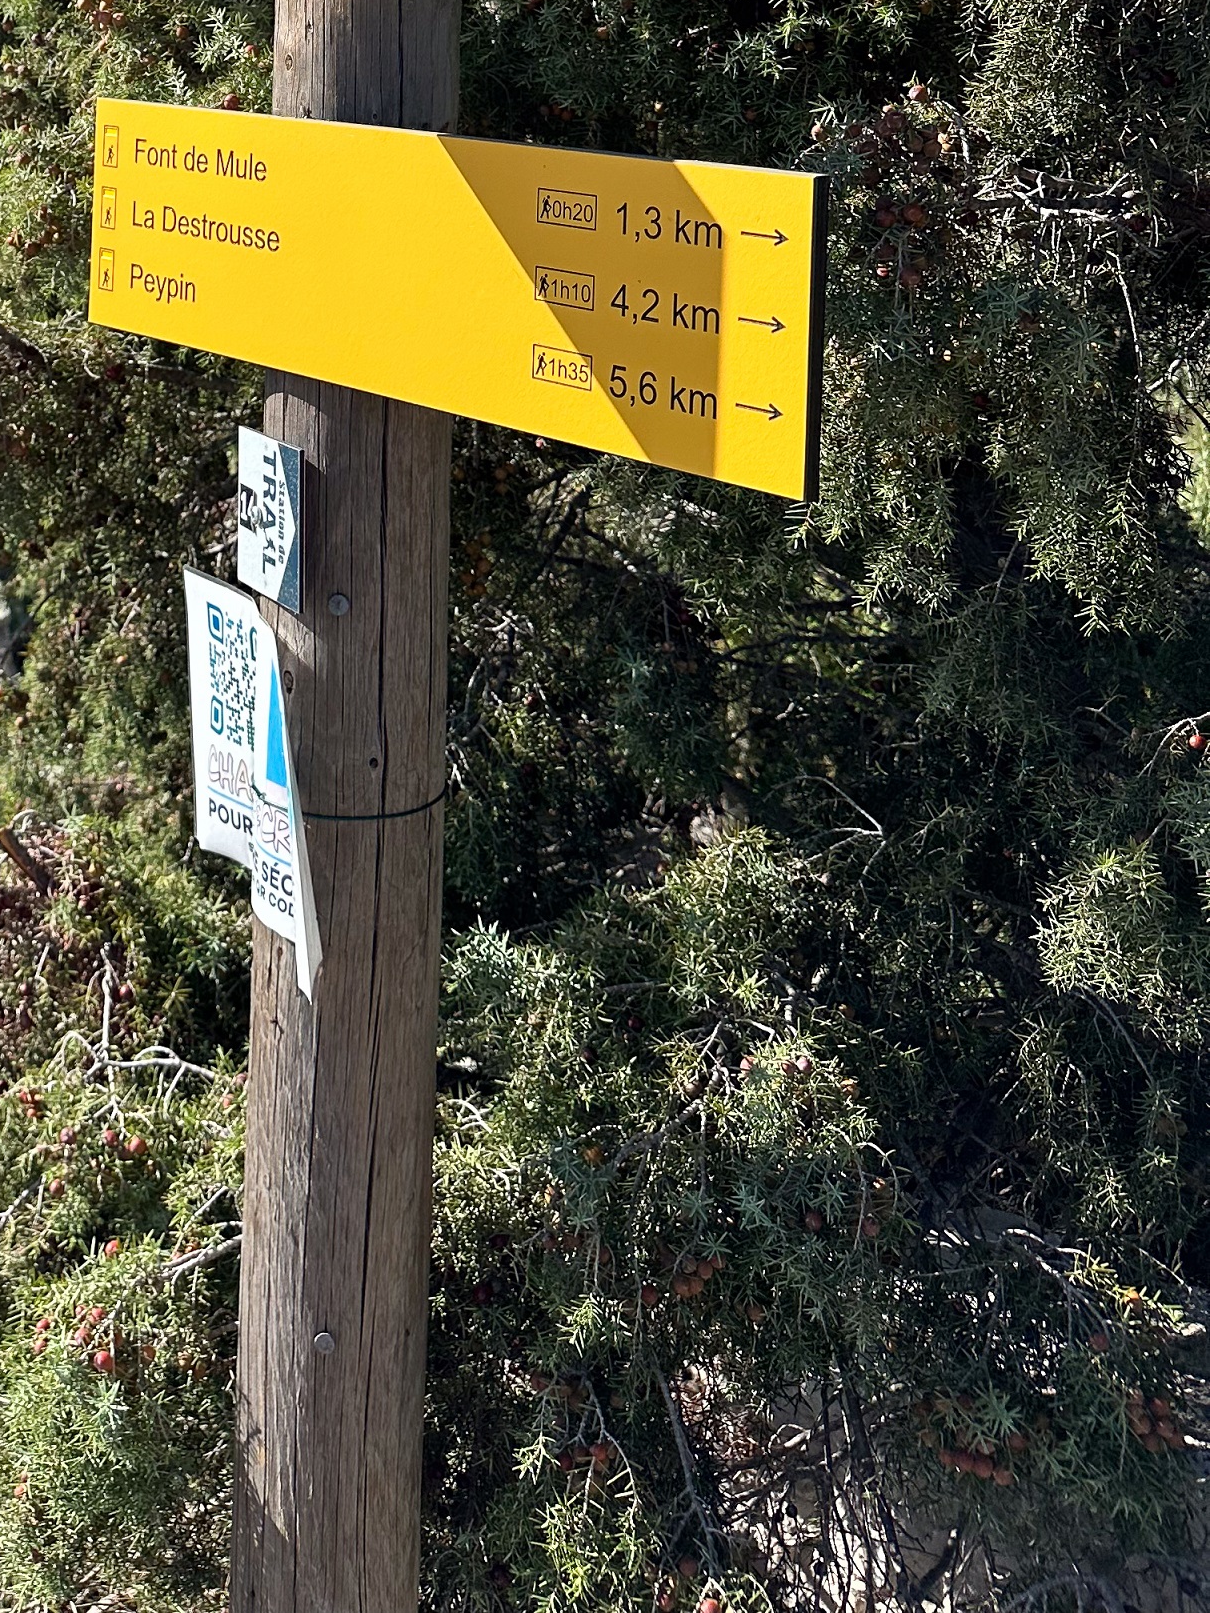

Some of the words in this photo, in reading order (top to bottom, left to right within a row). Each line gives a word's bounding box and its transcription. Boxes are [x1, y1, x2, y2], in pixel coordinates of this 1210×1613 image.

[134, 138, 178, 170] Font
[183, 145, 209, 174] de
[216, 148, 268, 183] Mule
[131, 200, 155, 230] La
[161, 205, 281, 253] Destrousse
[551, 200, 594, 224] 0h20
[615, 202, 663, 243] 1,3
[674, 209, 723, 249] km
[129, 263, 197, 305] Peypin
[550, 278, 592, 304] 1h10
[610, 283, 660, 325] 4,2
[671, 292, 720, 335] km
[548, 358, 590, 384] 1h35
[608, 364, 658, 408] 5,6
[669, 375, 718, 421] km
[208, 796, 254, 837] POUR
